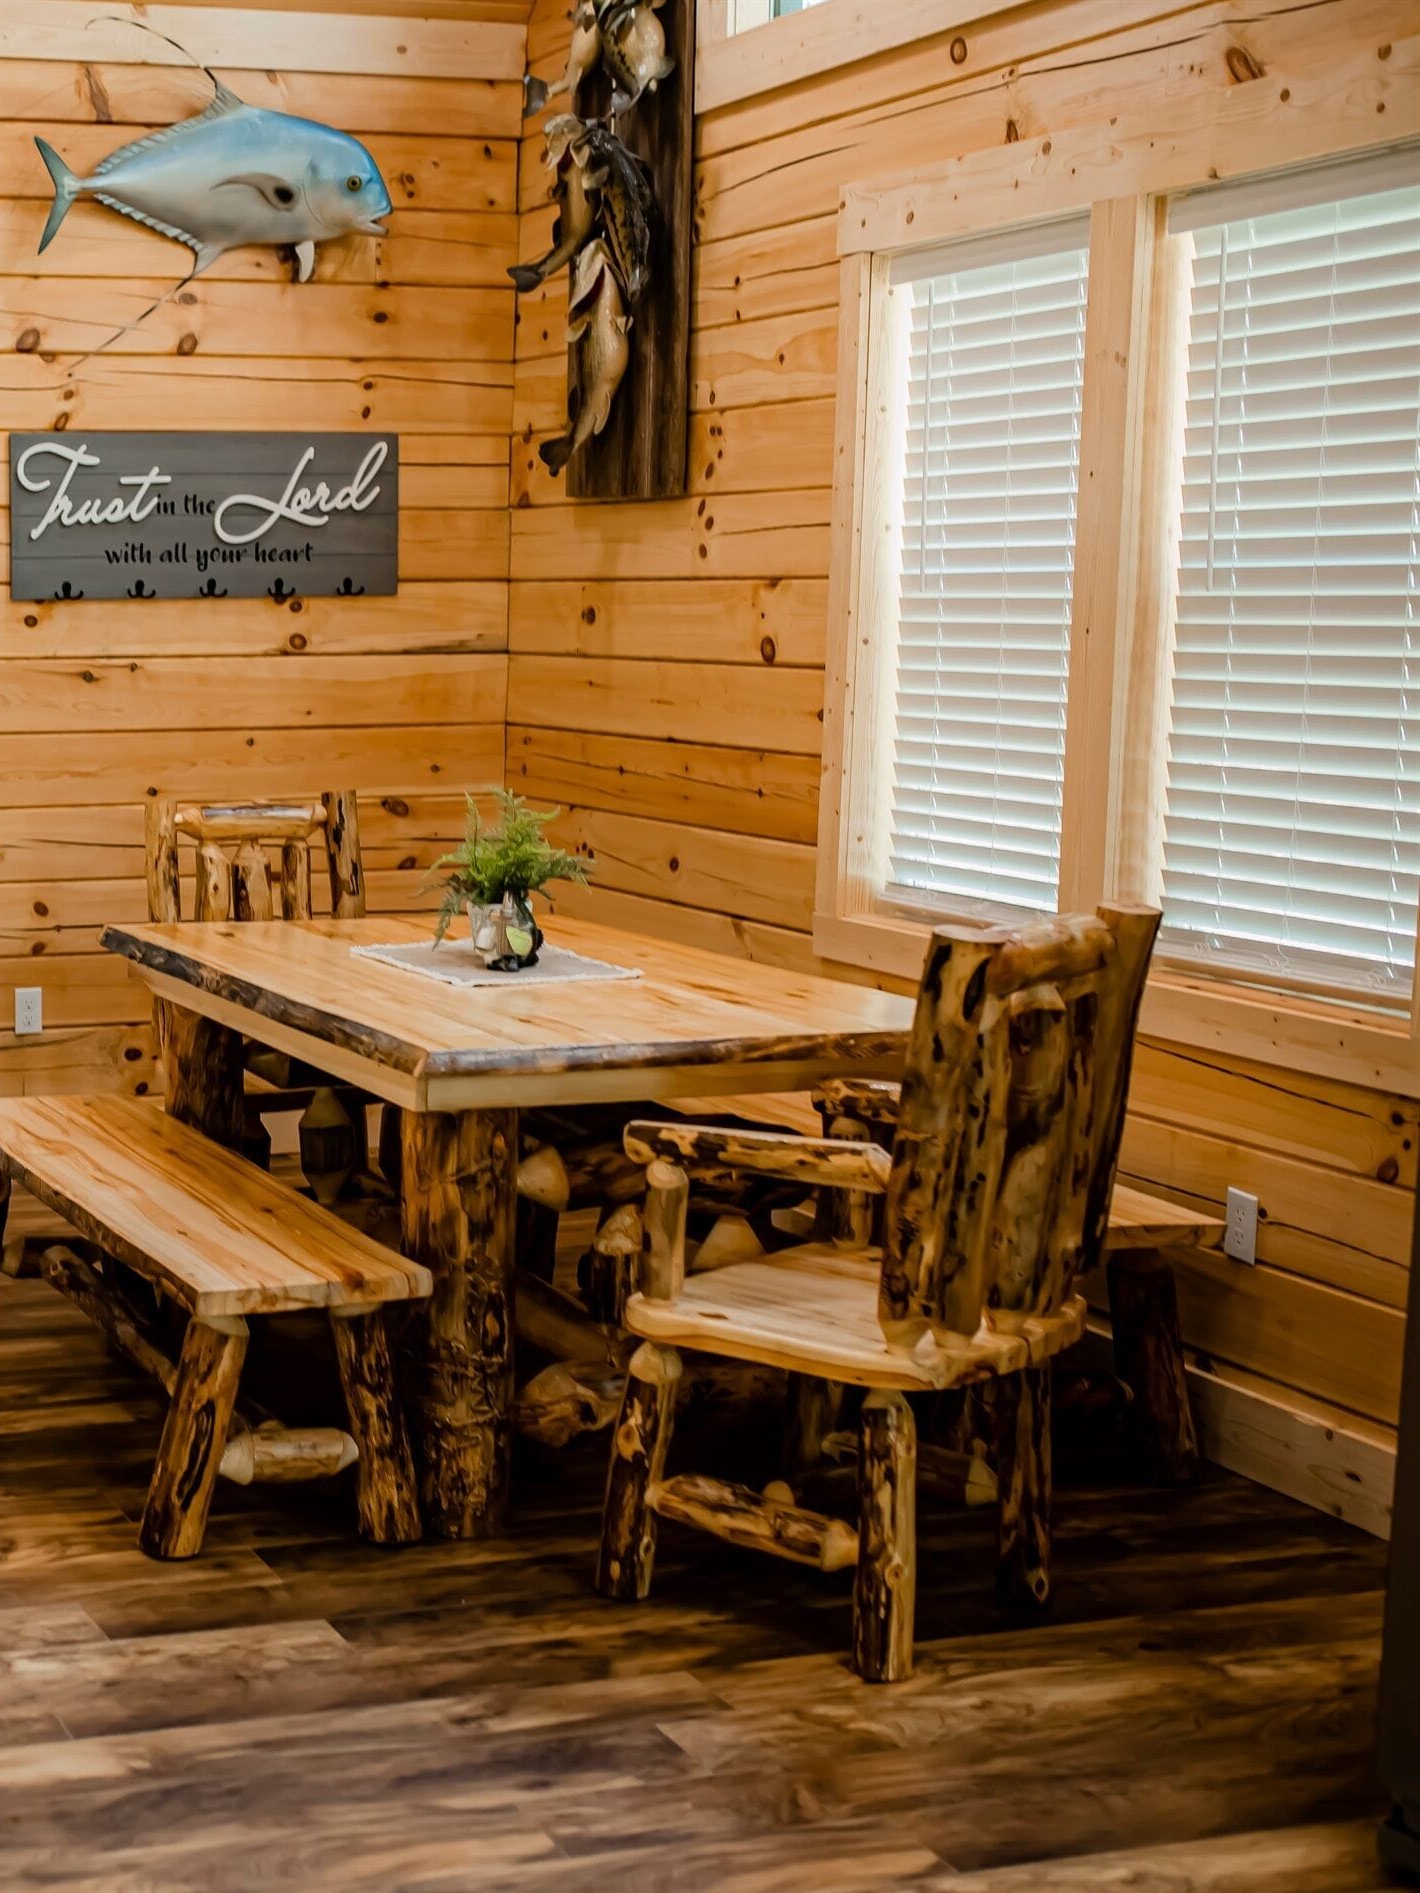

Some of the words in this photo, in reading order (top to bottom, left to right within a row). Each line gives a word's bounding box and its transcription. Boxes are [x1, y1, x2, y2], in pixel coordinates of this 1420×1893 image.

[17, 442, 172, 540] Trust
[156, 493, 174, 515] in
[185, 493, 216, 515] the
[214, 441, 388, 544] Lord
[105, 542, 152, 565] with
[160, 542, 188, 564] all
[196, 544, 246, 572] your
[255, 541, 313, 563] heart
